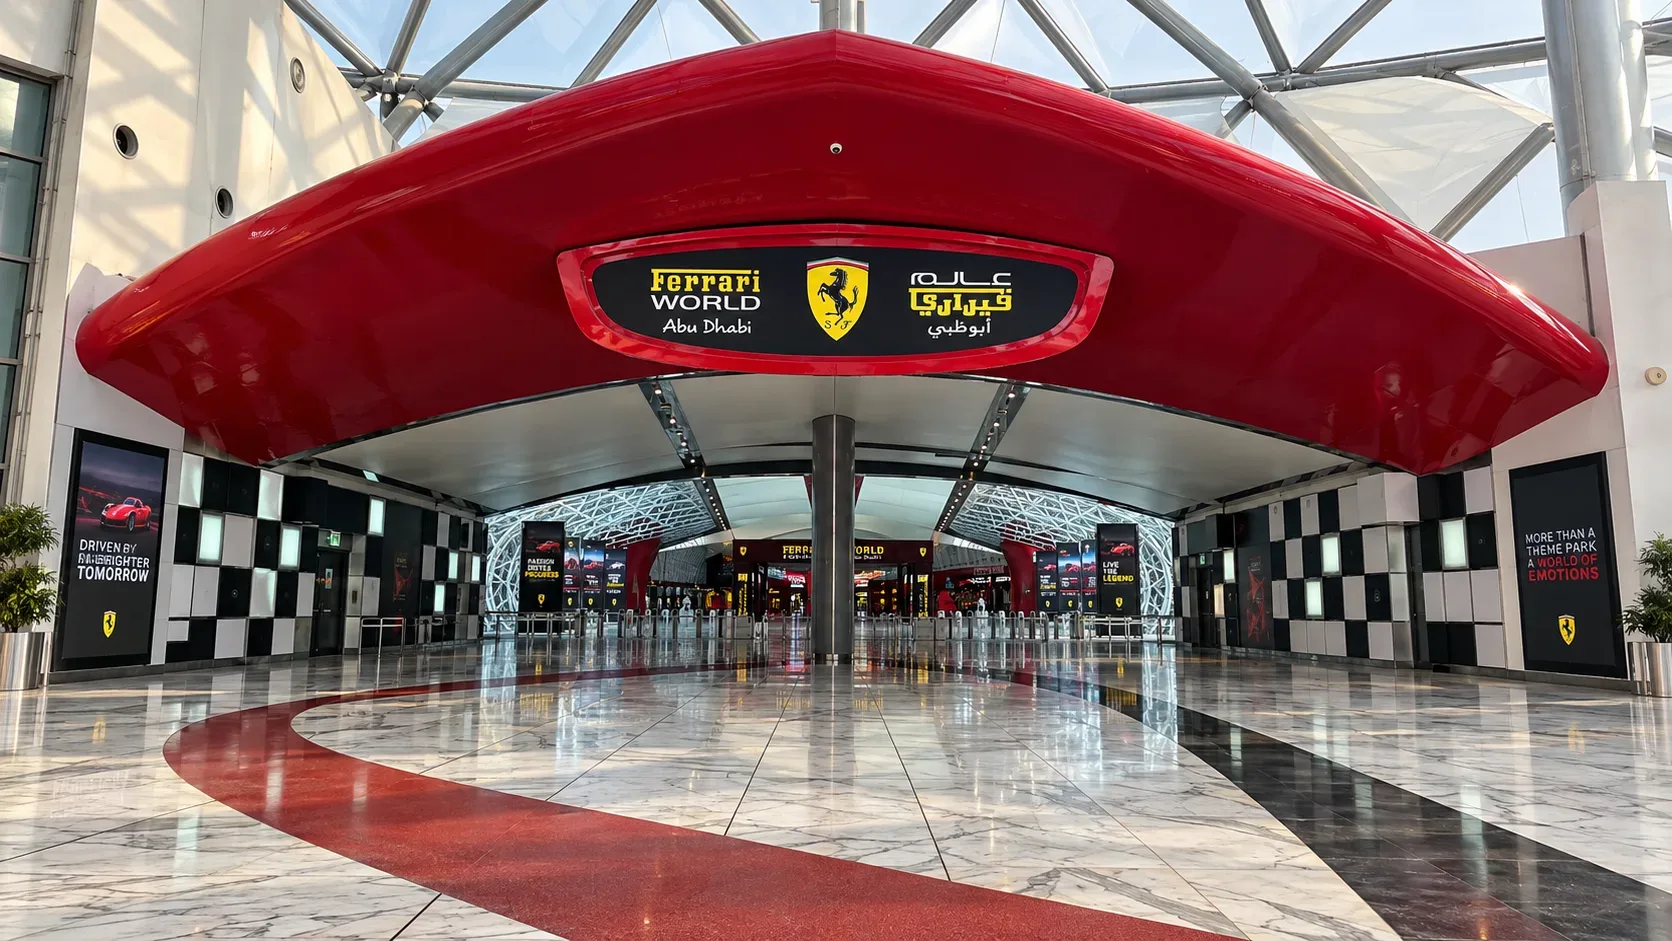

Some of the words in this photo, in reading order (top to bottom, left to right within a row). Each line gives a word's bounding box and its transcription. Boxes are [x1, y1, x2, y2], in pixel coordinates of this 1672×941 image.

[650, 268, 761, 292] Ferrari
[910, 271, 1012, 286] عالم
[650, 294, 761, 310] WORLD
[908, 287, 1012, 316] فيراري
[662, 318, 698, 333] Abu
[703, 318, 752, 334] Dhabi
[1525, 531, 1554, 544] MORE
[1556, 528, 1585, 541] THAN
[1587, 527, 1596, 538] A
[79, 538, 121, 553] DRIVEN
[122, 543, 138, 554] BY
[855, 545, 885, 555] ORLD
[1526, 543, 1563, 556] THEME
[1565, 540, 1597, 553] PARK
[1527, 559, 1535, 568] A
[1537, 555, 1578, 568] WORLD
[1581, 553, 1598, 565] OF
[77, 565, 150, 582] TOMORROW
[1528, 566, 1599, 581] EMOTIONS
